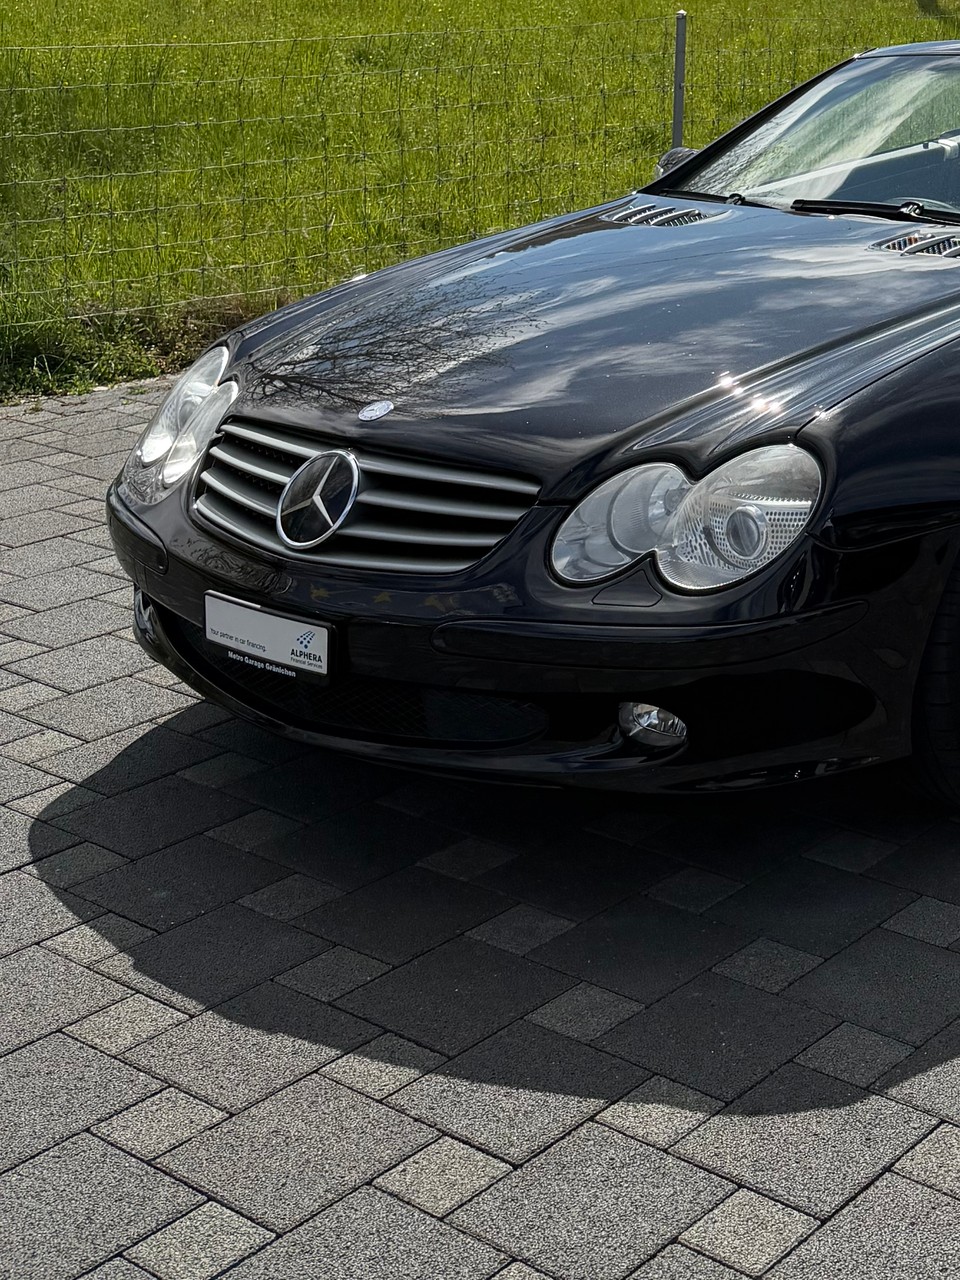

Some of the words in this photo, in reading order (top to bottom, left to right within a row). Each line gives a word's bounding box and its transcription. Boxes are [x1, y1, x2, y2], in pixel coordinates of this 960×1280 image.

[227, 651, 244, 662] Metro
[244, 656, 265, 669] Garage
[290, 648, 323, 664] ALPHERA
[290, 657, 307, 666] Financial
[306, 660, 323, 670] Services
